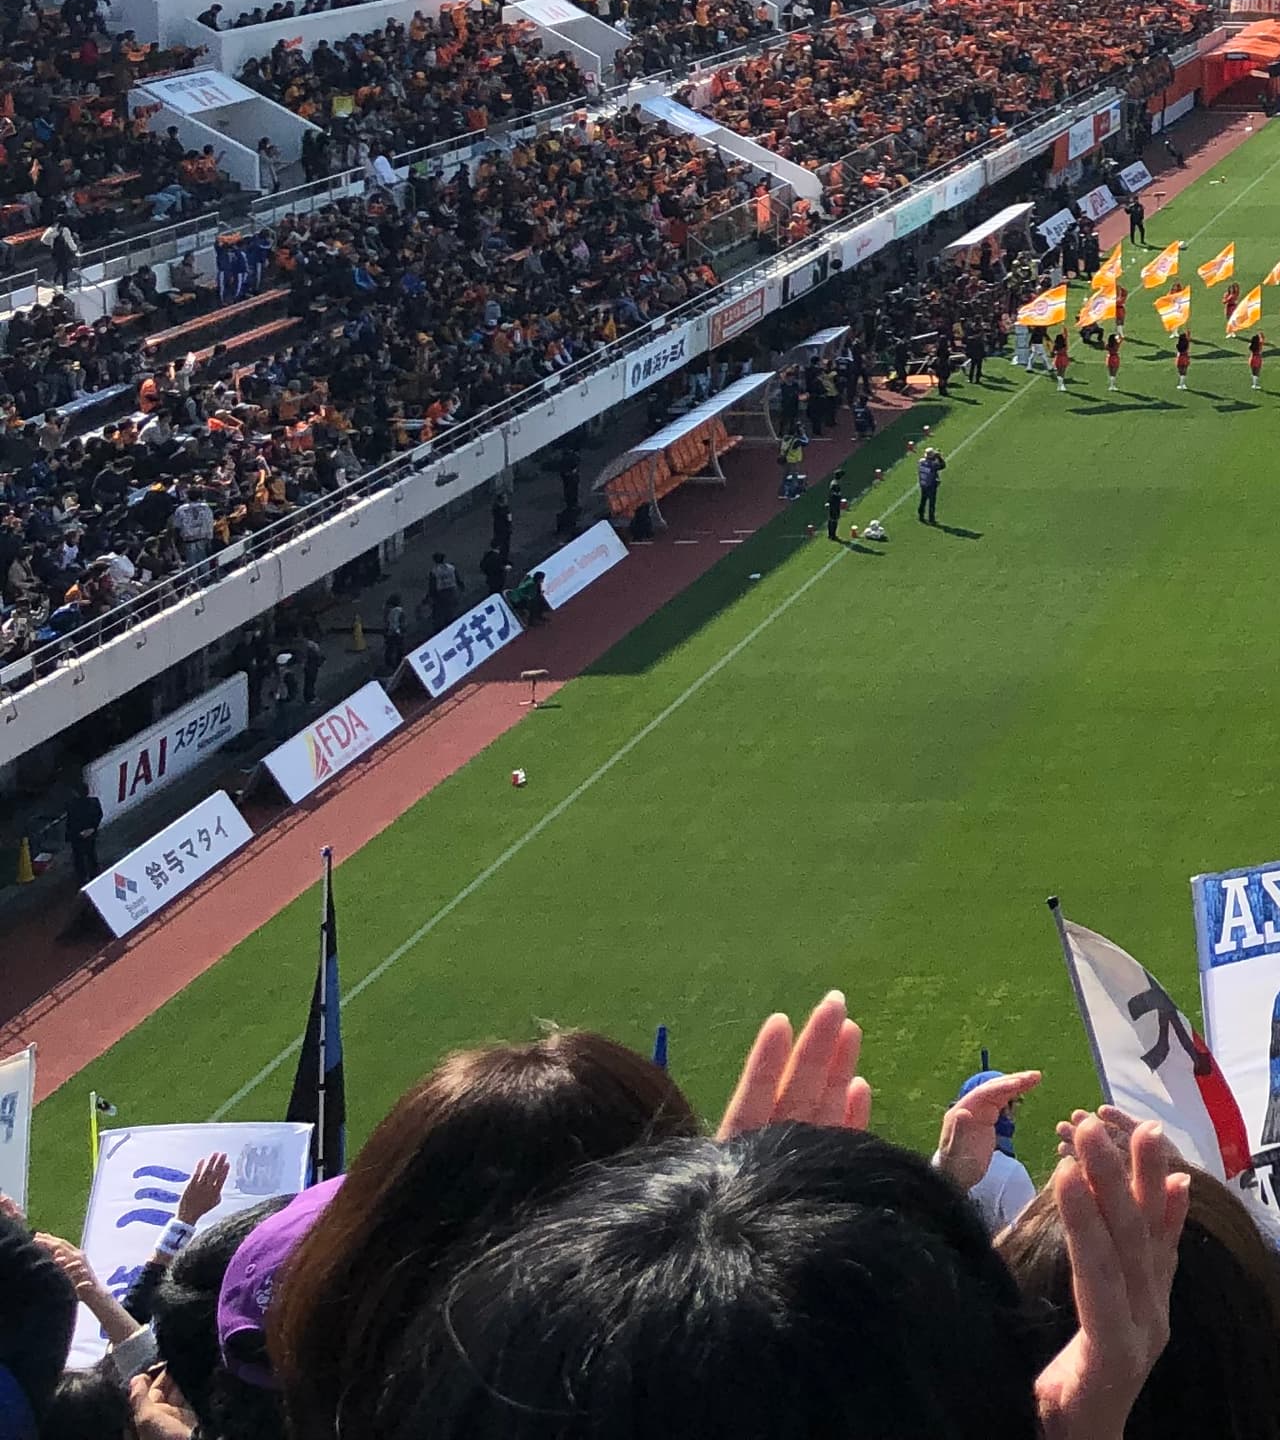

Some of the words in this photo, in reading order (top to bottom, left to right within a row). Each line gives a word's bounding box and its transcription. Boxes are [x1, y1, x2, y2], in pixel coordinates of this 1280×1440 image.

[418, 600, 513, 691] シーチキン
[117, 736, 168, 804] IAI
[173, 700, 232, 754] スタジアム
[314, 704, 369, 759] FDA
[144, 815, 230, 891] 鈴与マタイ
